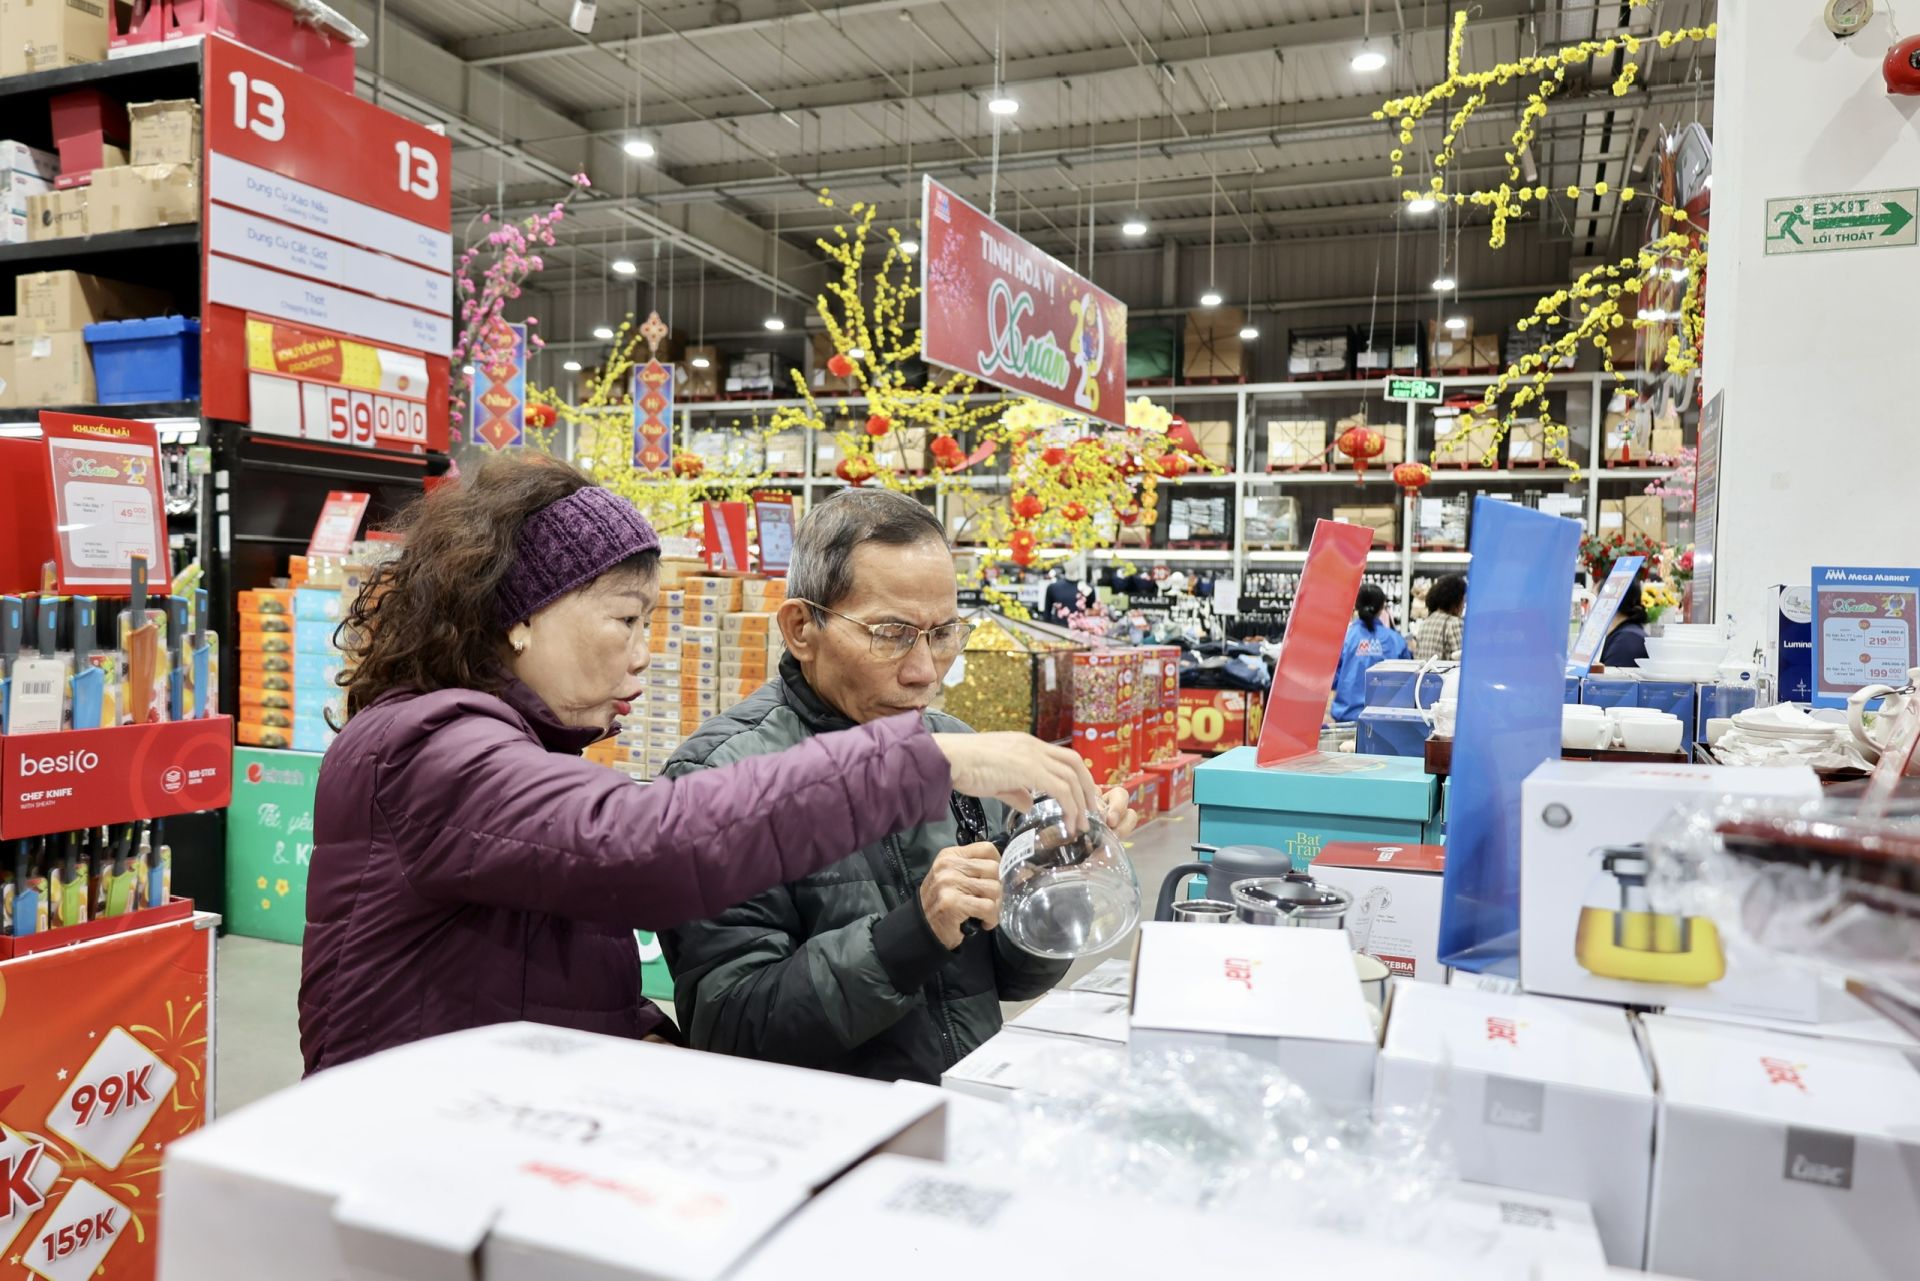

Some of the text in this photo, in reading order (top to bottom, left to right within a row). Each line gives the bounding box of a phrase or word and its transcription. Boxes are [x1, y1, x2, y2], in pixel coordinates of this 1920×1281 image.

[229, 71, 285, 141] 13
[395, 141, 438, 199] 13
[1813, 199, 1870, 216] EXIT
[1813, 231, 1874, 244] LỐI THOÁT
[980, 230, 1012, 271] TINH
[1015, 255, 1041, 290] HOA
[977, 278, 1071, 391] Xuân
[1868, 637, 1888, 646] 219
[1869, 668, 1888, 678] 199
[20, 787, 73, 802] CHEF KNIFE
[273, 841, 290, 864] &
[70, 1063, 155, 1129] 99K
[41, 1206, 119, 1263] 159K
